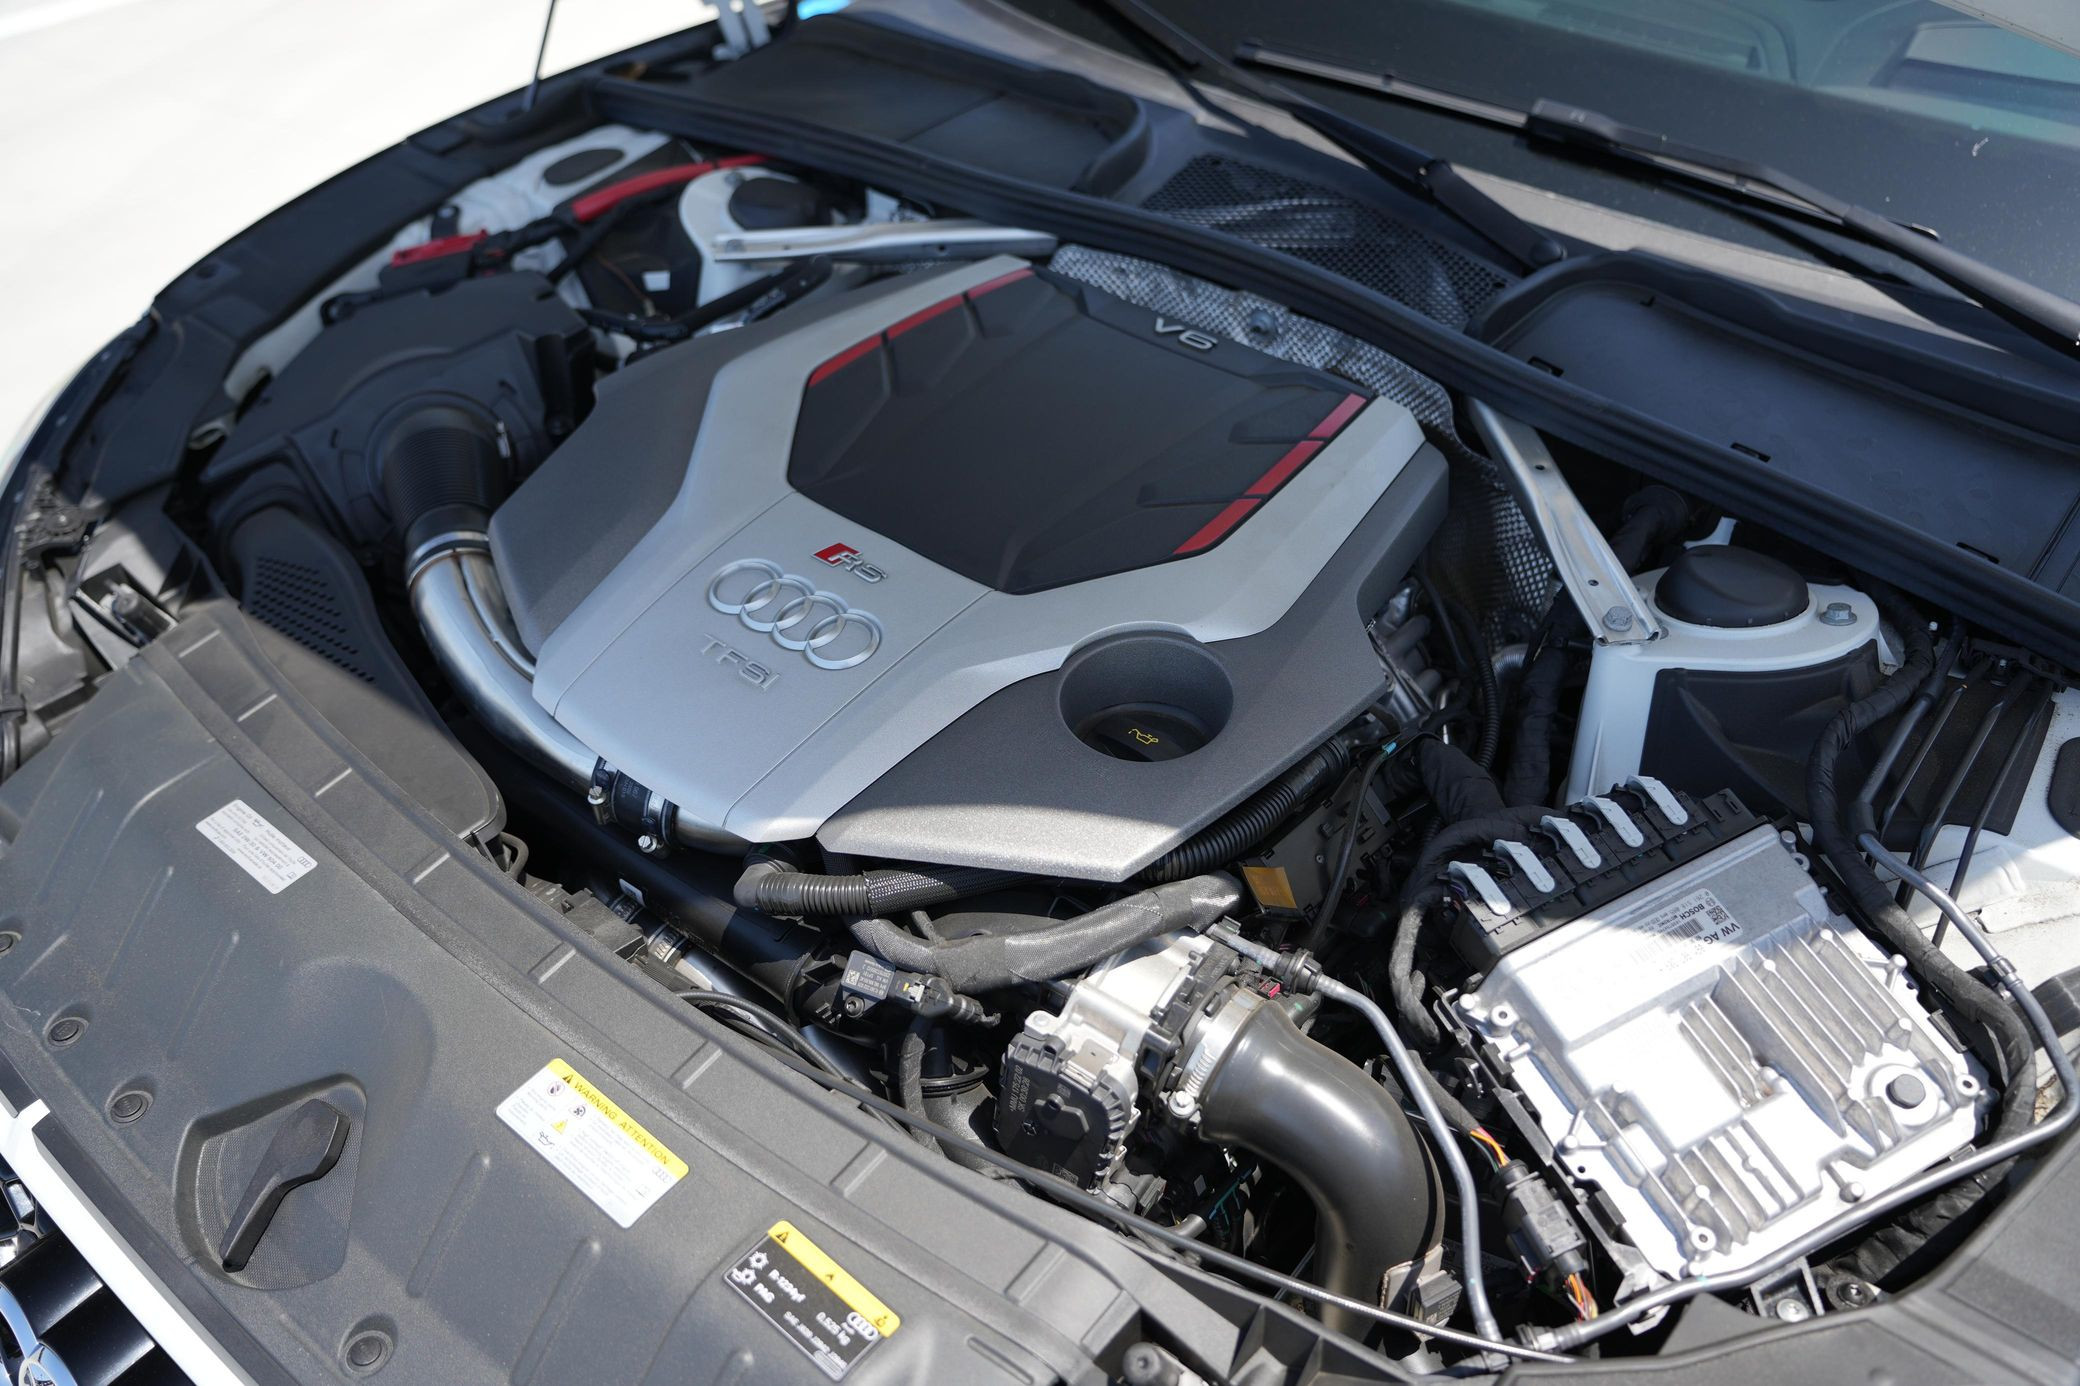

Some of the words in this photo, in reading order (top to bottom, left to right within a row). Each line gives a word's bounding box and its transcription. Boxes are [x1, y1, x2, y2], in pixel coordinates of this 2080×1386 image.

[1155, 317, 1218, 350] V6
[815, 545, 888, 584] RS
[701, 633, 781, 691] TFSI
[1679, 903, 1705, 920] BOSCH
[1703, 930, 1720, 945] AG
[1721, 922, 1741, 937] VW
[574, 1082, 618, 1121] WARNING
[619, 1120, 670, 1165] ATTENTION
